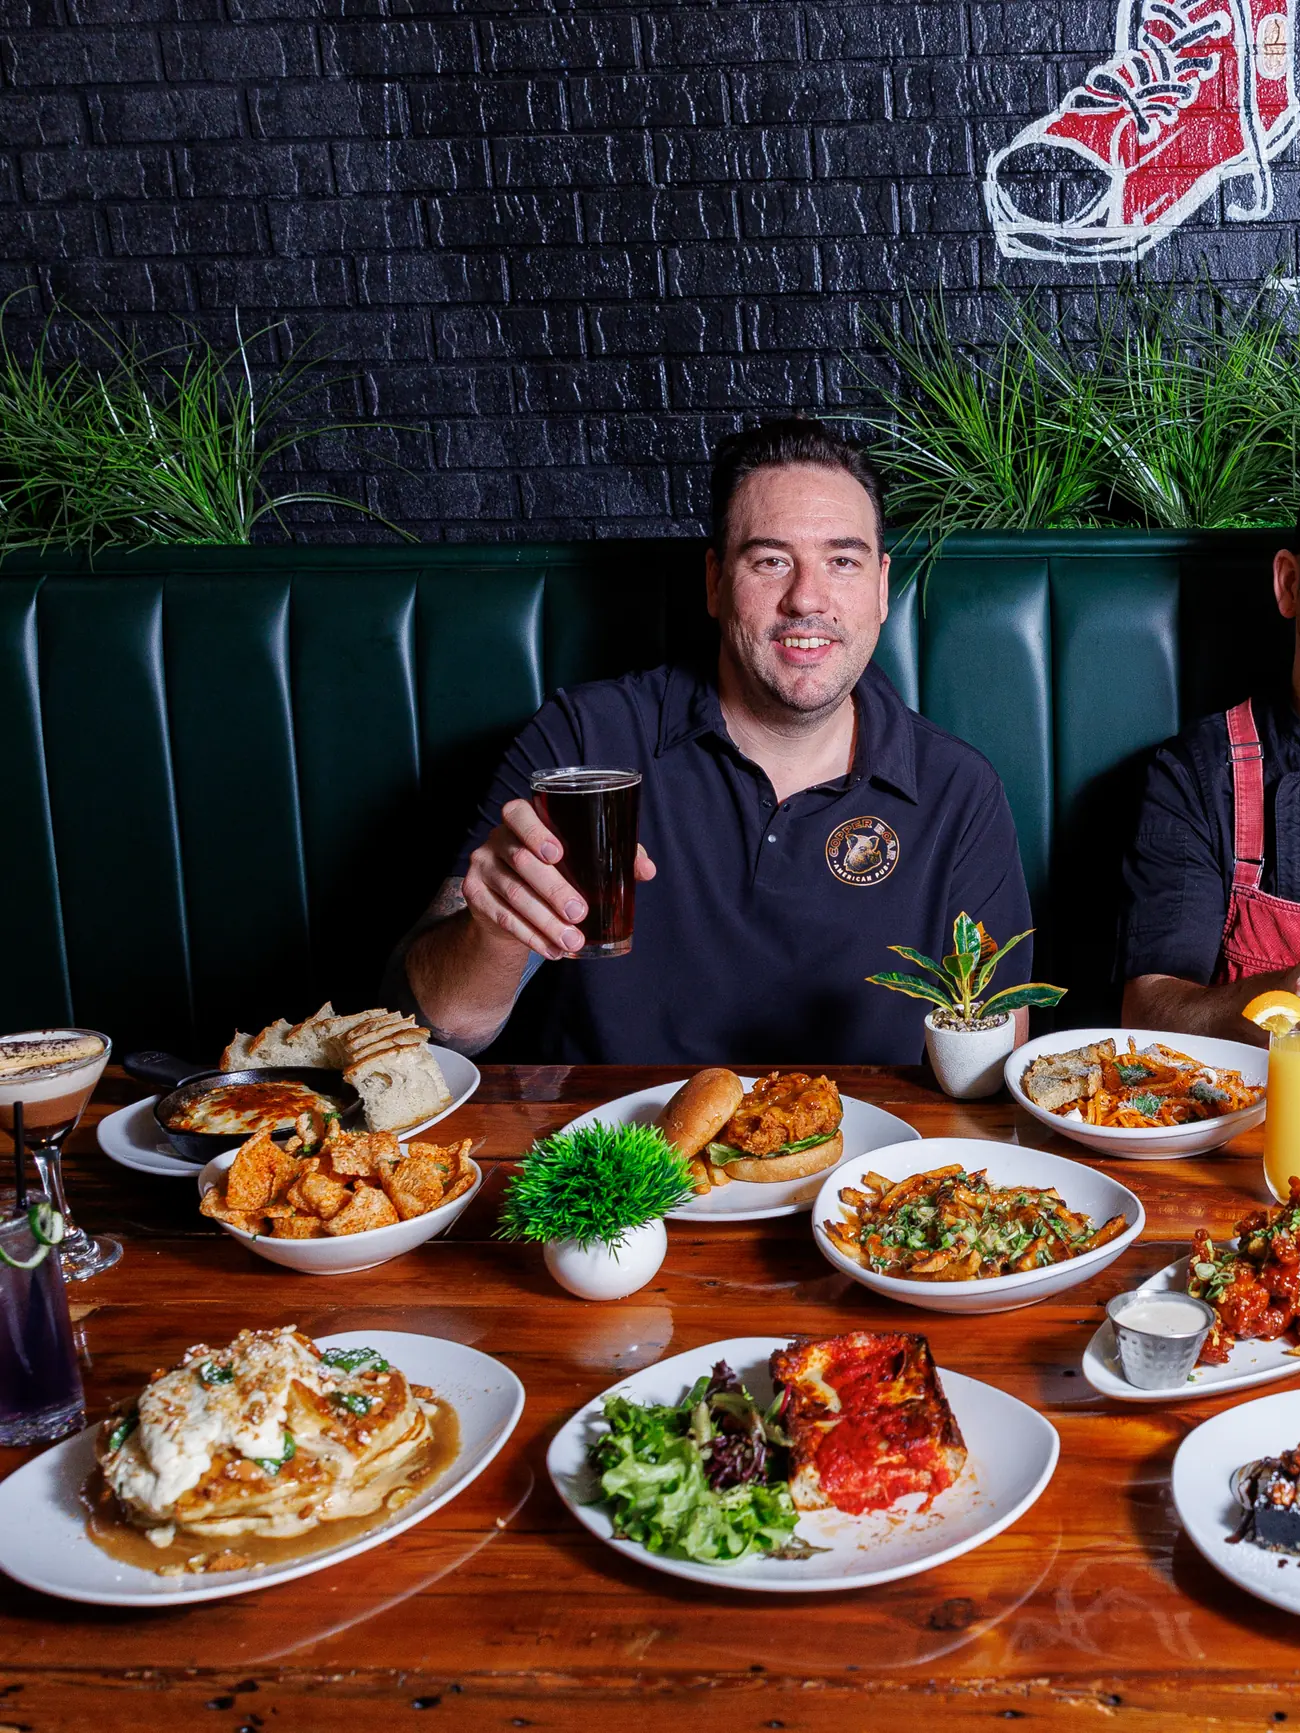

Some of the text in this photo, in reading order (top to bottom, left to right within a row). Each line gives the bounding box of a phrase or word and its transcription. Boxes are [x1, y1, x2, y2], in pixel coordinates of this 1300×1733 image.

[829, 819, 896, 860] COPPER BOAR
[834, 864, 889, 882] AMERICAN PUB
